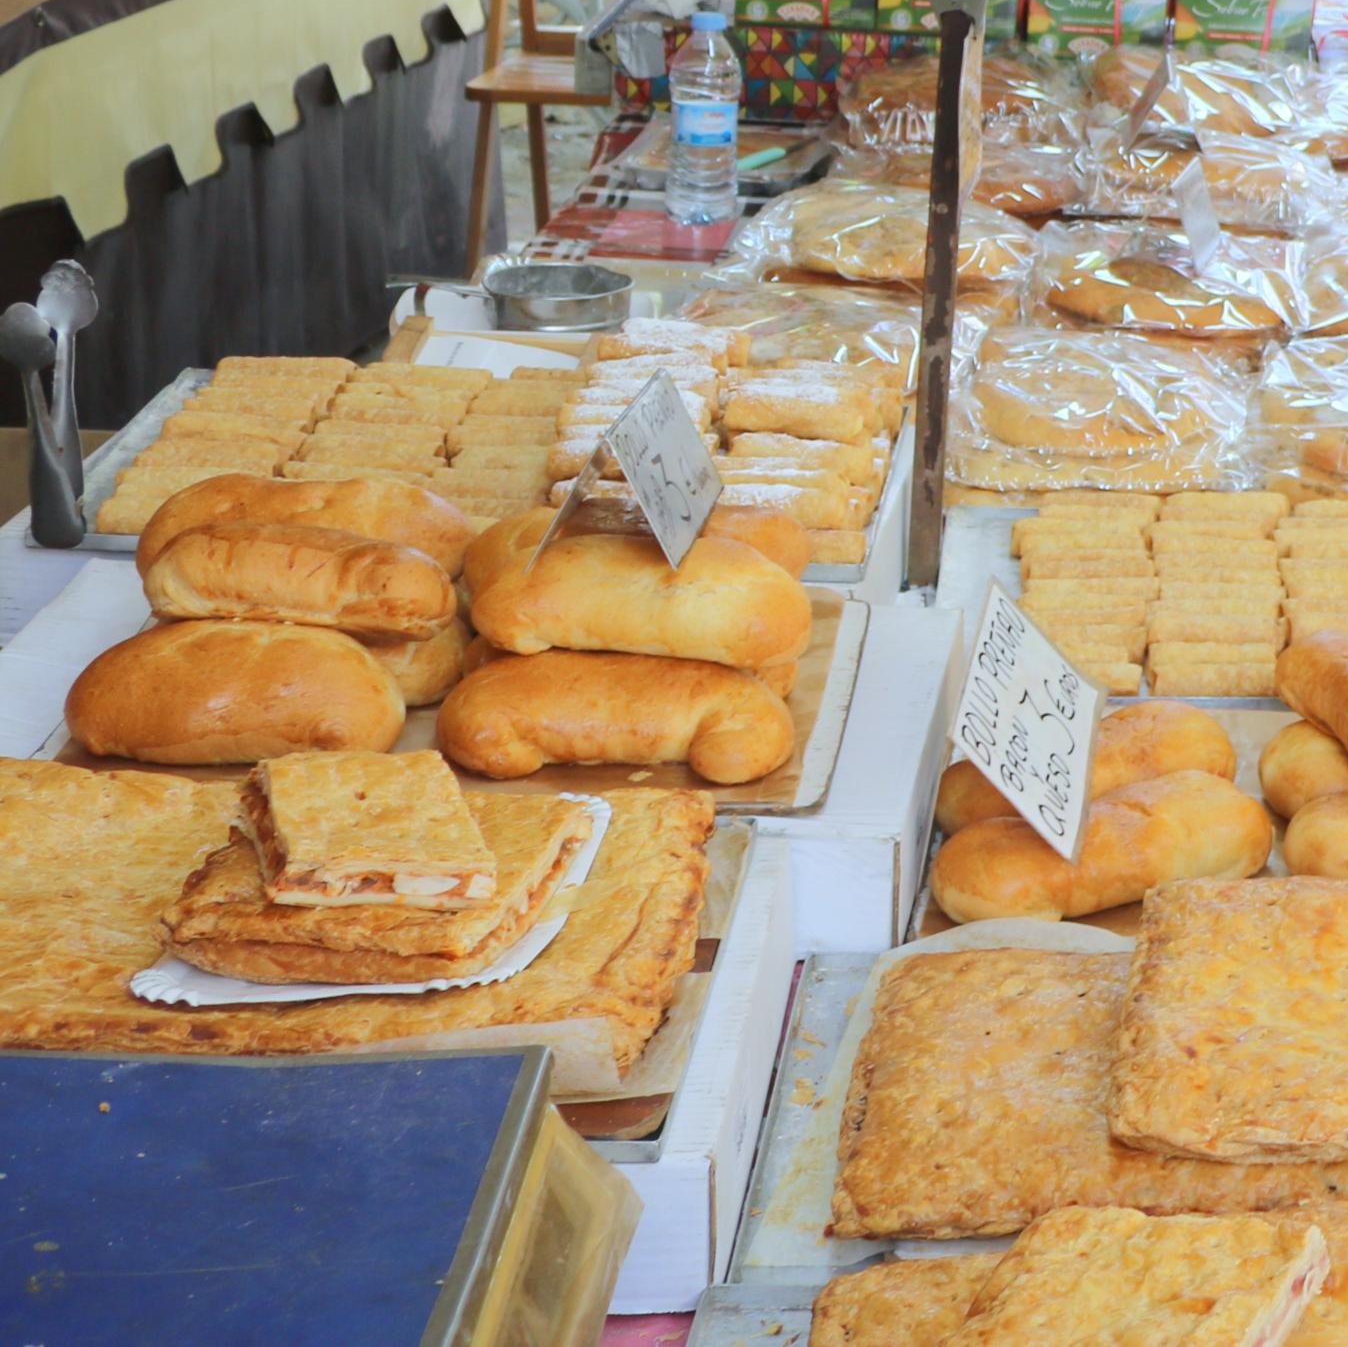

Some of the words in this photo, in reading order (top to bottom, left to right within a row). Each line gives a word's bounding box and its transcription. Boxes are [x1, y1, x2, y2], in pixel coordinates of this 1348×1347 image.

[961, 677, 999, 767] BOLLO
[1000, 716, 1029, 792] BACON
[1019, 689, 1076, 756] 3
[1038, 752, 1072, 837] QUESO
